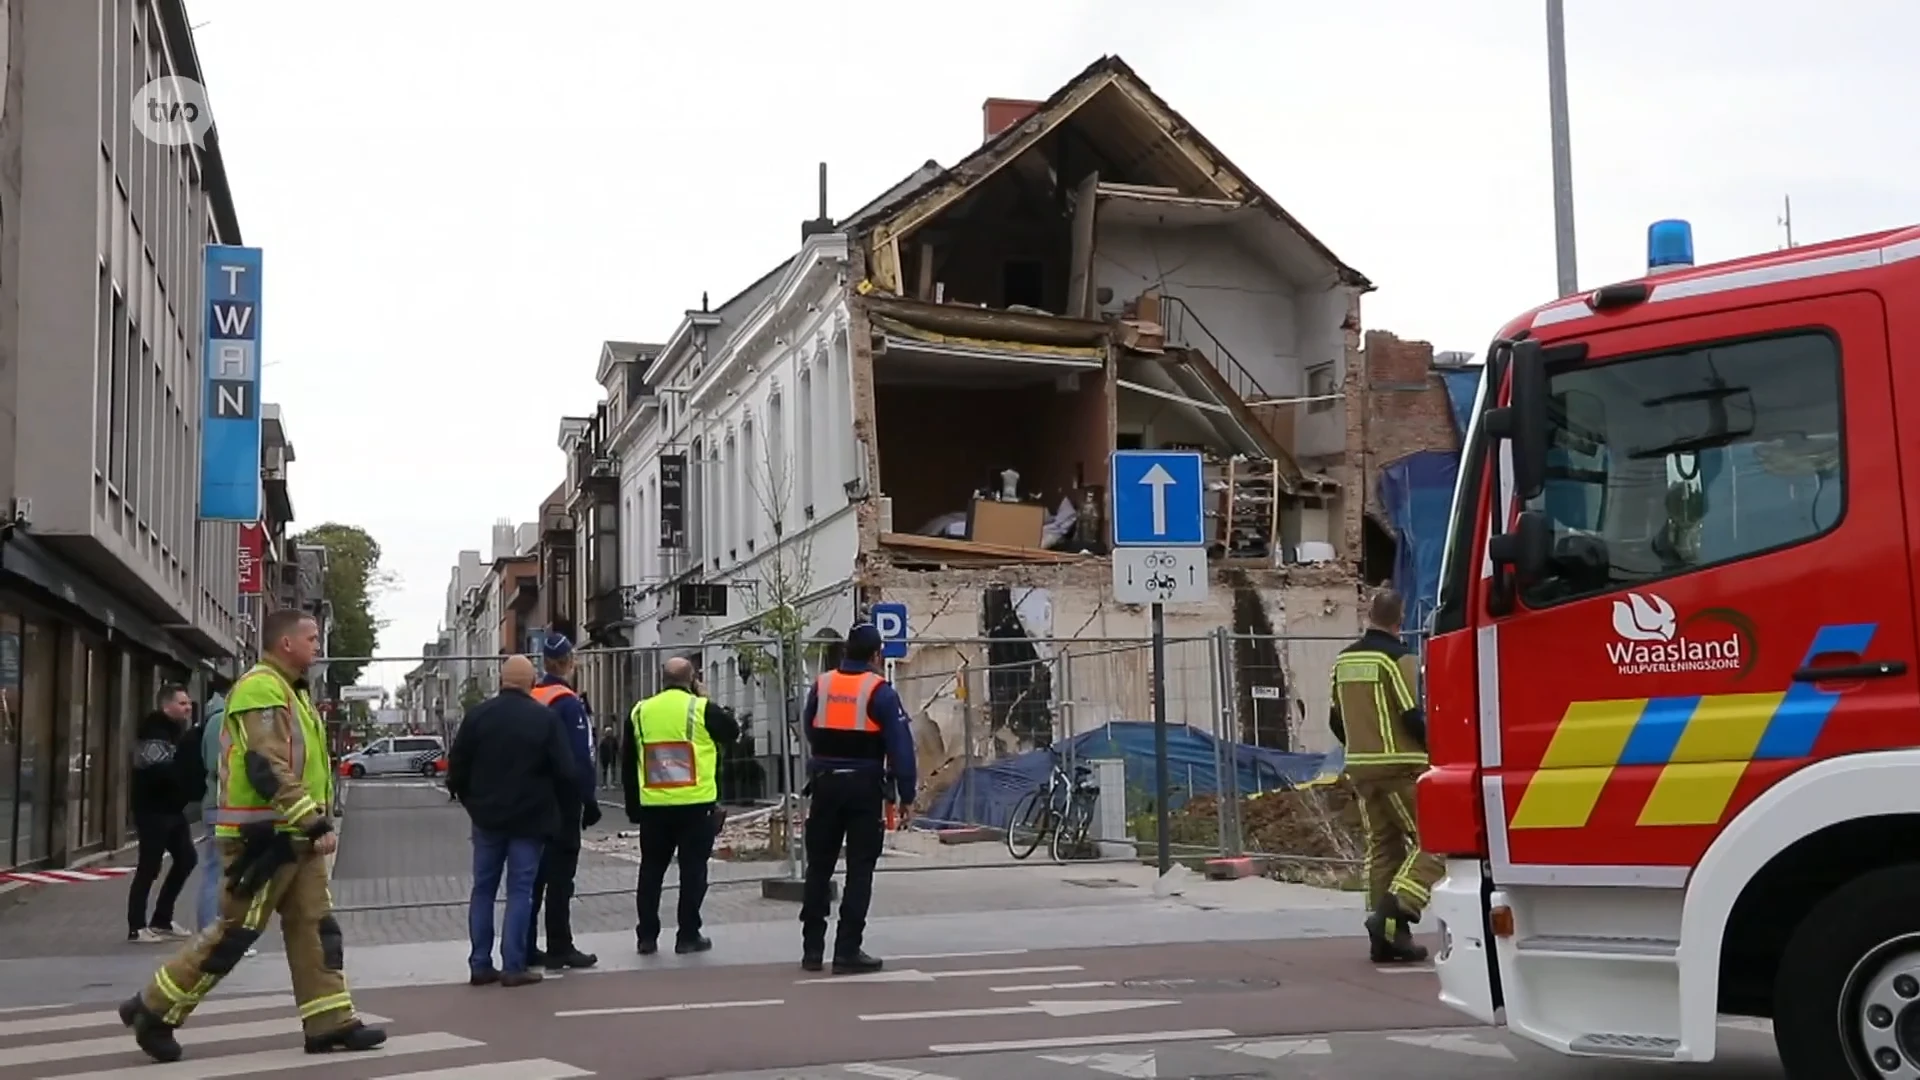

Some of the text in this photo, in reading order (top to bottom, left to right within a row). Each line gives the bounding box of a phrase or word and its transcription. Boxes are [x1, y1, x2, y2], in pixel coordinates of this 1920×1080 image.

[212, 265, 252, 417] TWAN
[1606, 633, 1741, 664] Waasland
[1618, 659, 1741, 675] HULPVERLENINGSZONE
